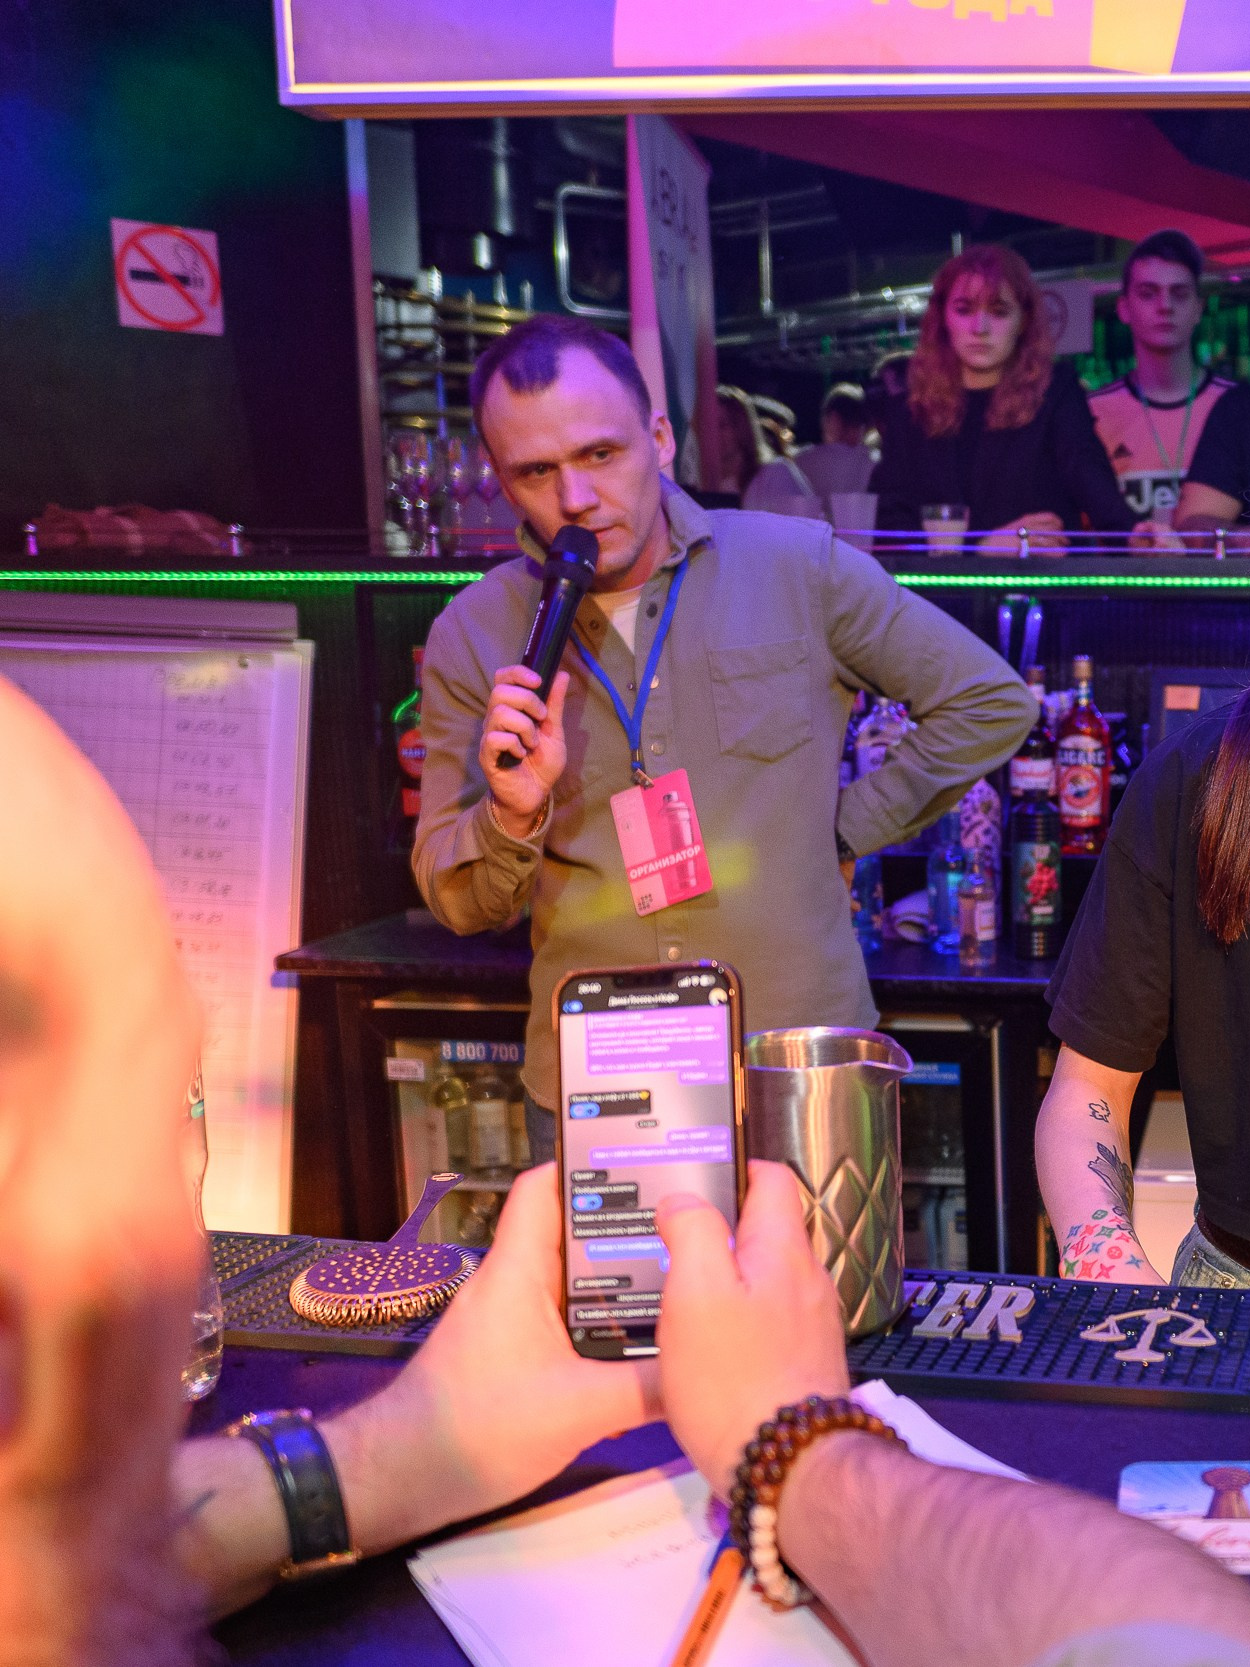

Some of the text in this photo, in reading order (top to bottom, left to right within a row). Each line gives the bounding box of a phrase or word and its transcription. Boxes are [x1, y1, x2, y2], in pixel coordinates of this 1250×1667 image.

[1125, 479, 1179, 514] Je
[629, 844, 701, 880] ОРГАНИЗАТОР
[456, 1042, 486, 1061] 800
[490, 1043, 520, 1062] 700
